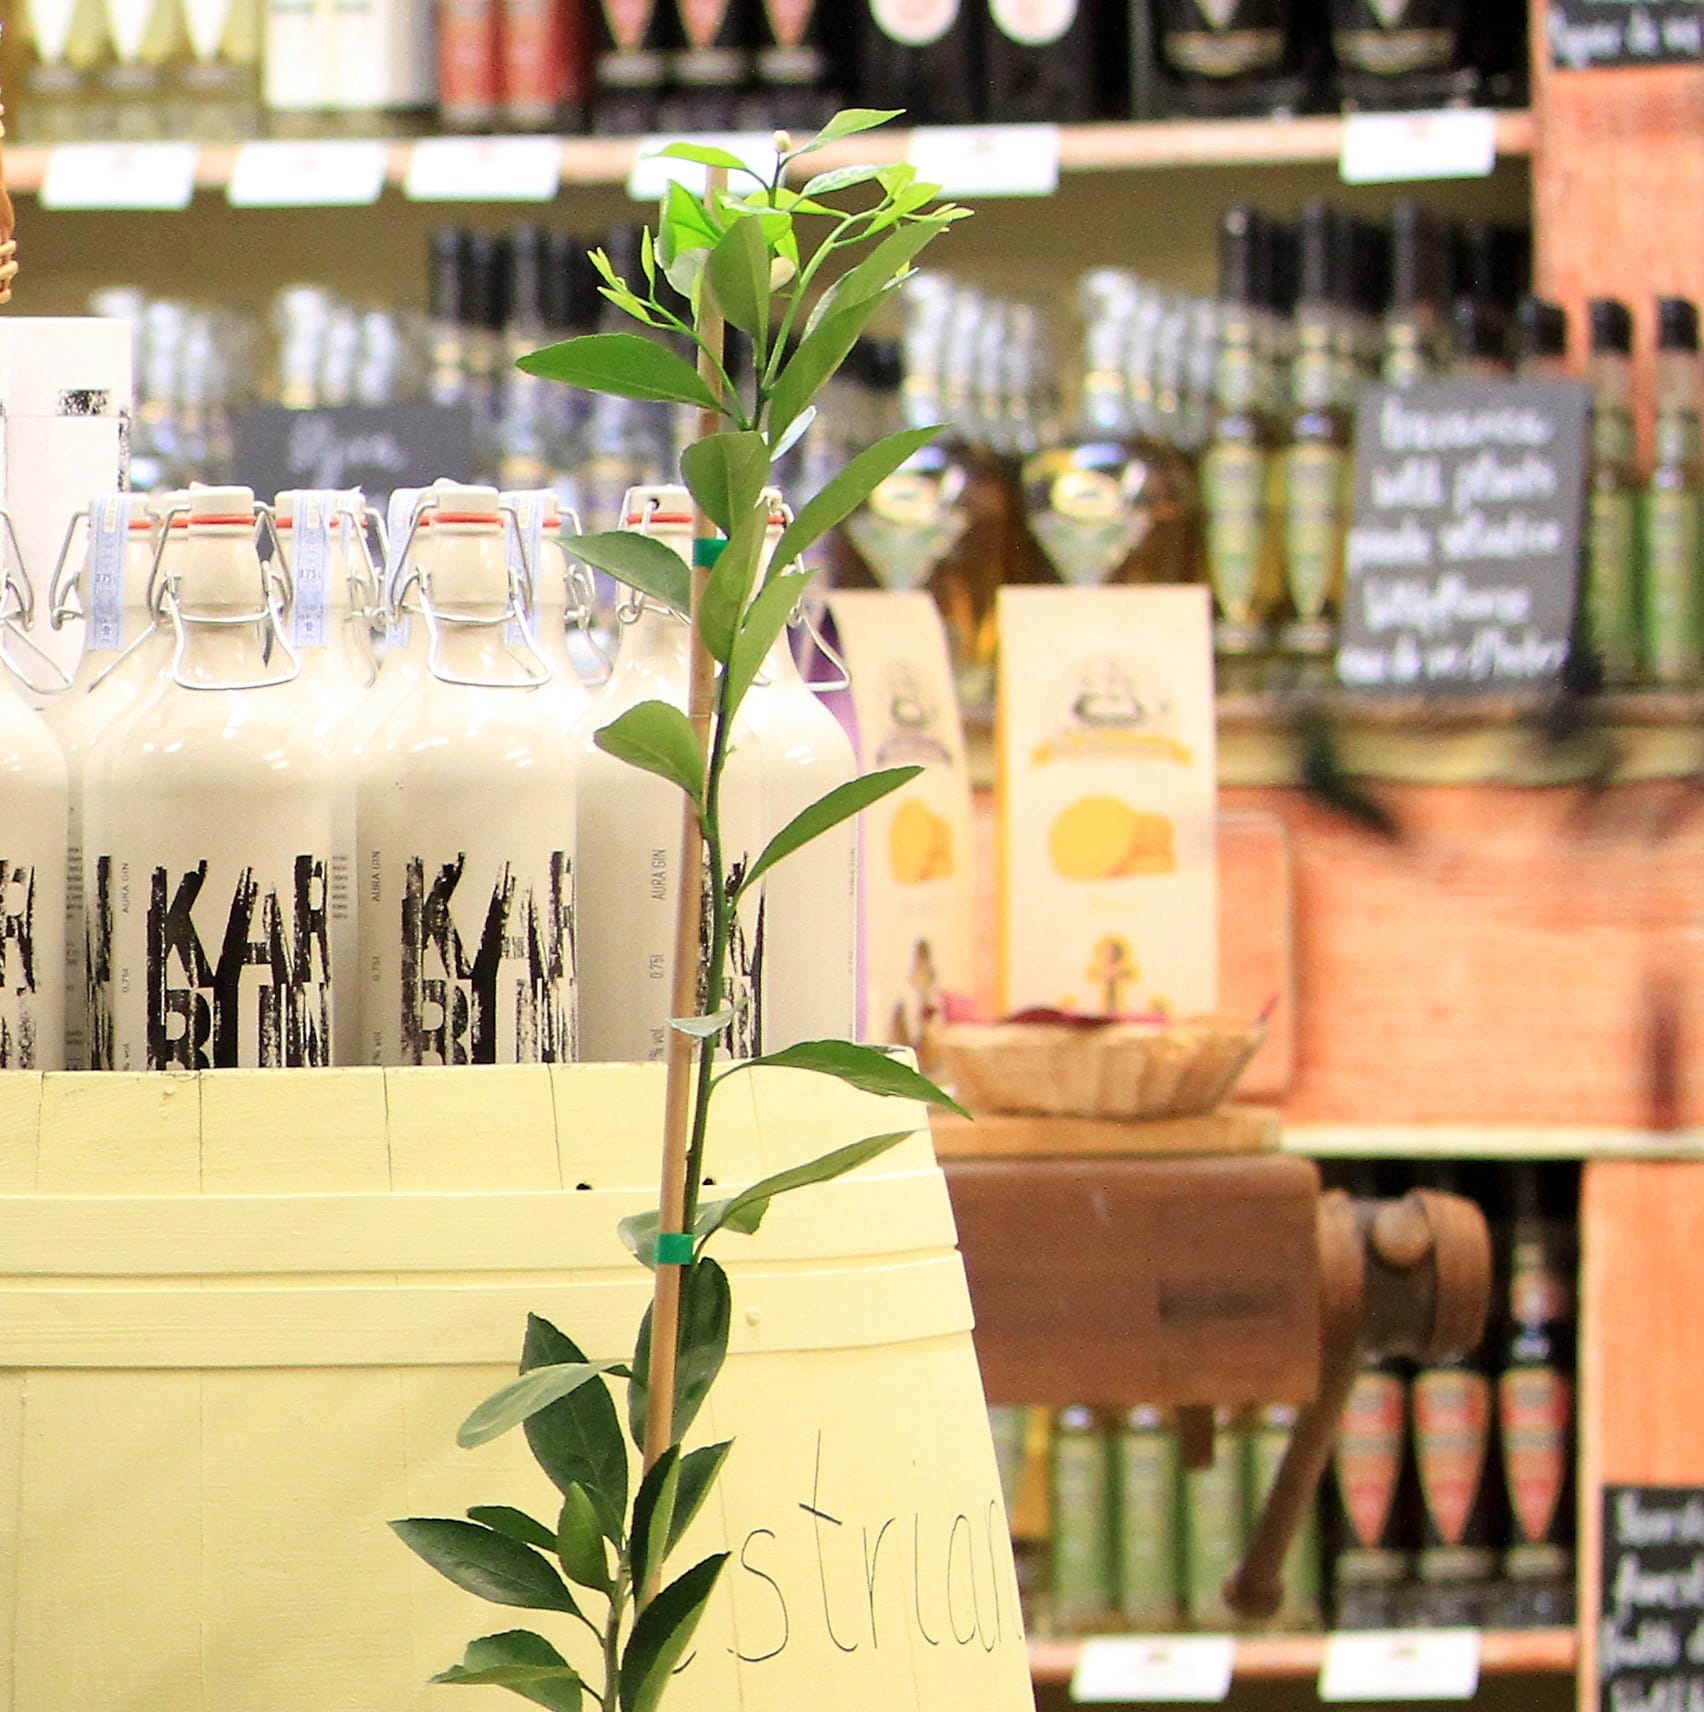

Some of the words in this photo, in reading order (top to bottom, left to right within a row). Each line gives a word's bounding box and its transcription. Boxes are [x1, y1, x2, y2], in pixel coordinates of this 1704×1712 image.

[651, 849, 666, 869] GIN
[651, 871, 667, 901] AURA
[672, 1429, 1022, 1676] strian
